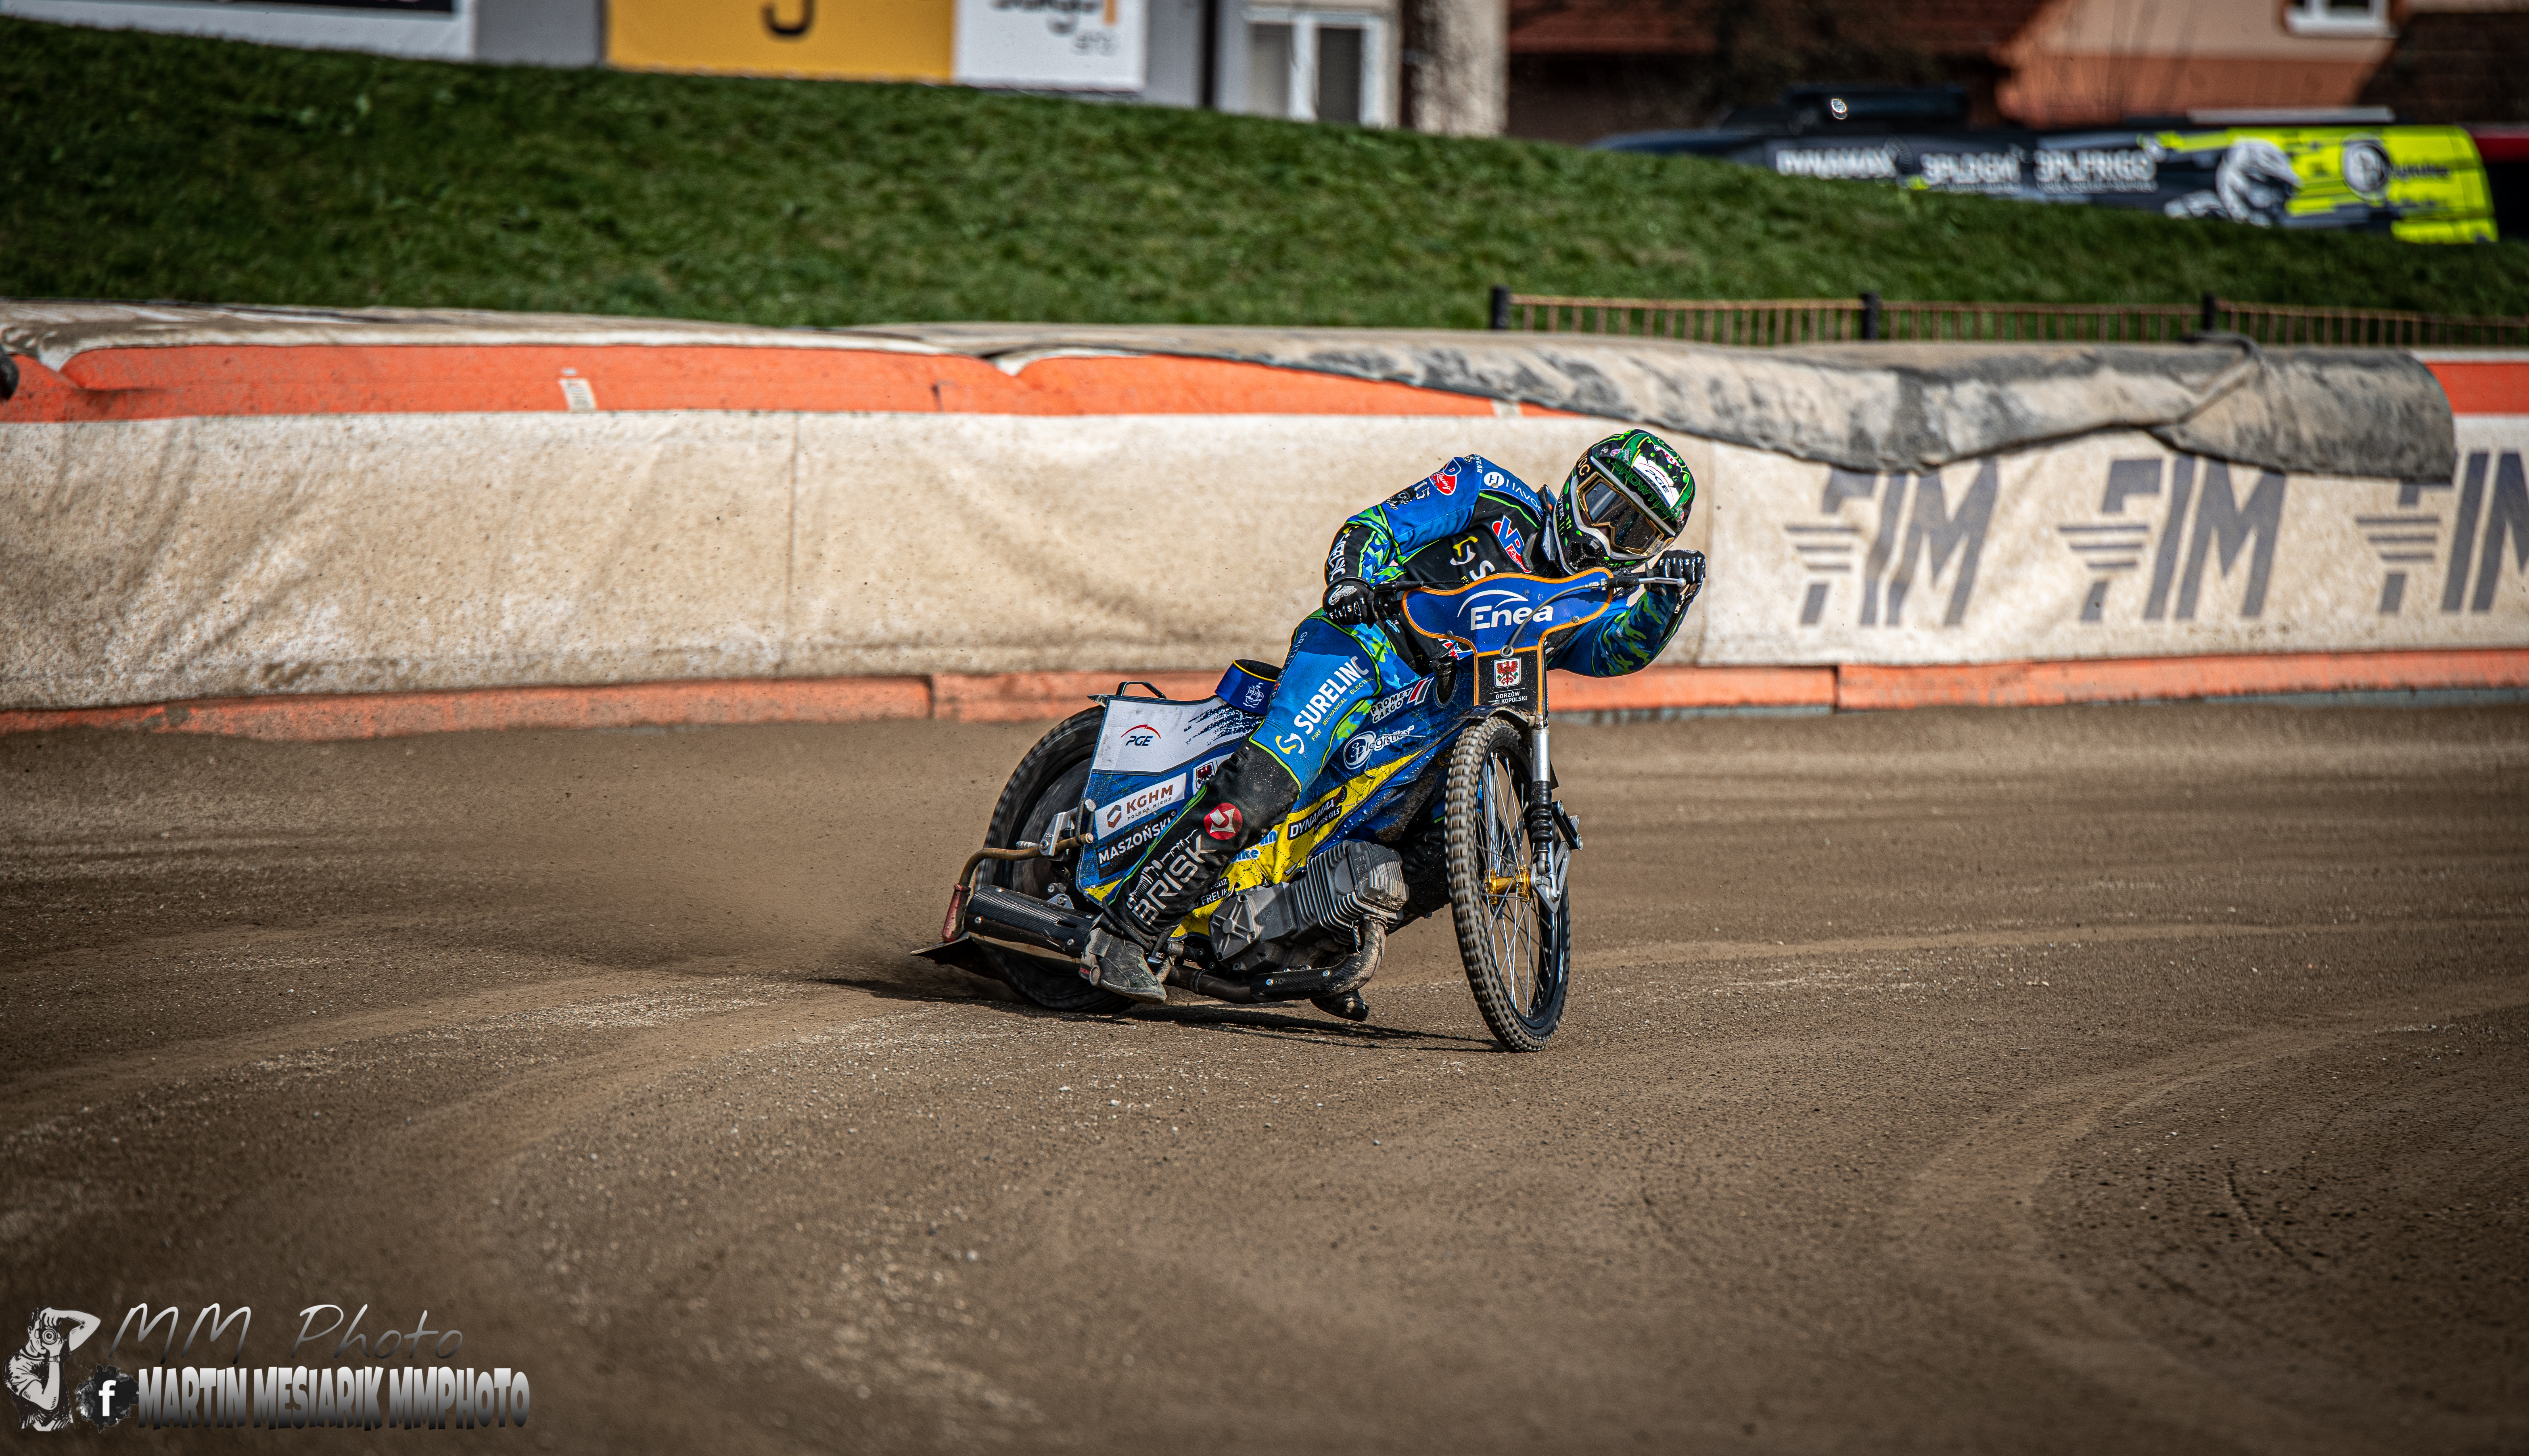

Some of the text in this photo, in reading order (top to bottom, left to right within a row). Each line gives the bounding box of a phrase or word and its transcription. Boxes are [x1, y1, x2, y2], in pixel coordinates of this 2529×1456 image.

[1645, 469, 1670, 493] PGE
[1497, 515, 1525, 556] VP
[2058, 455, 2286, 623] FIM
[1471, 605, 1553, 631] Enea
[1294, 656, 1369, 735] SURELINC
[1371, 688, 1412, 715] PROMET
[1496, 691, 1520, 699] GORZÓW
[1311, 729, 1322, 741] FIRE
[1323, 698, 1347, 726] MECHANICAL
[1373, 700, 1402, 723] CARGO
[1125, 735, 1153, 746] PGE
[1127, 784, 1173, 814] KGHM
[1127, 807, 1150, 821] POLSKA
[1132, 834, 1217, 926] BRISK
